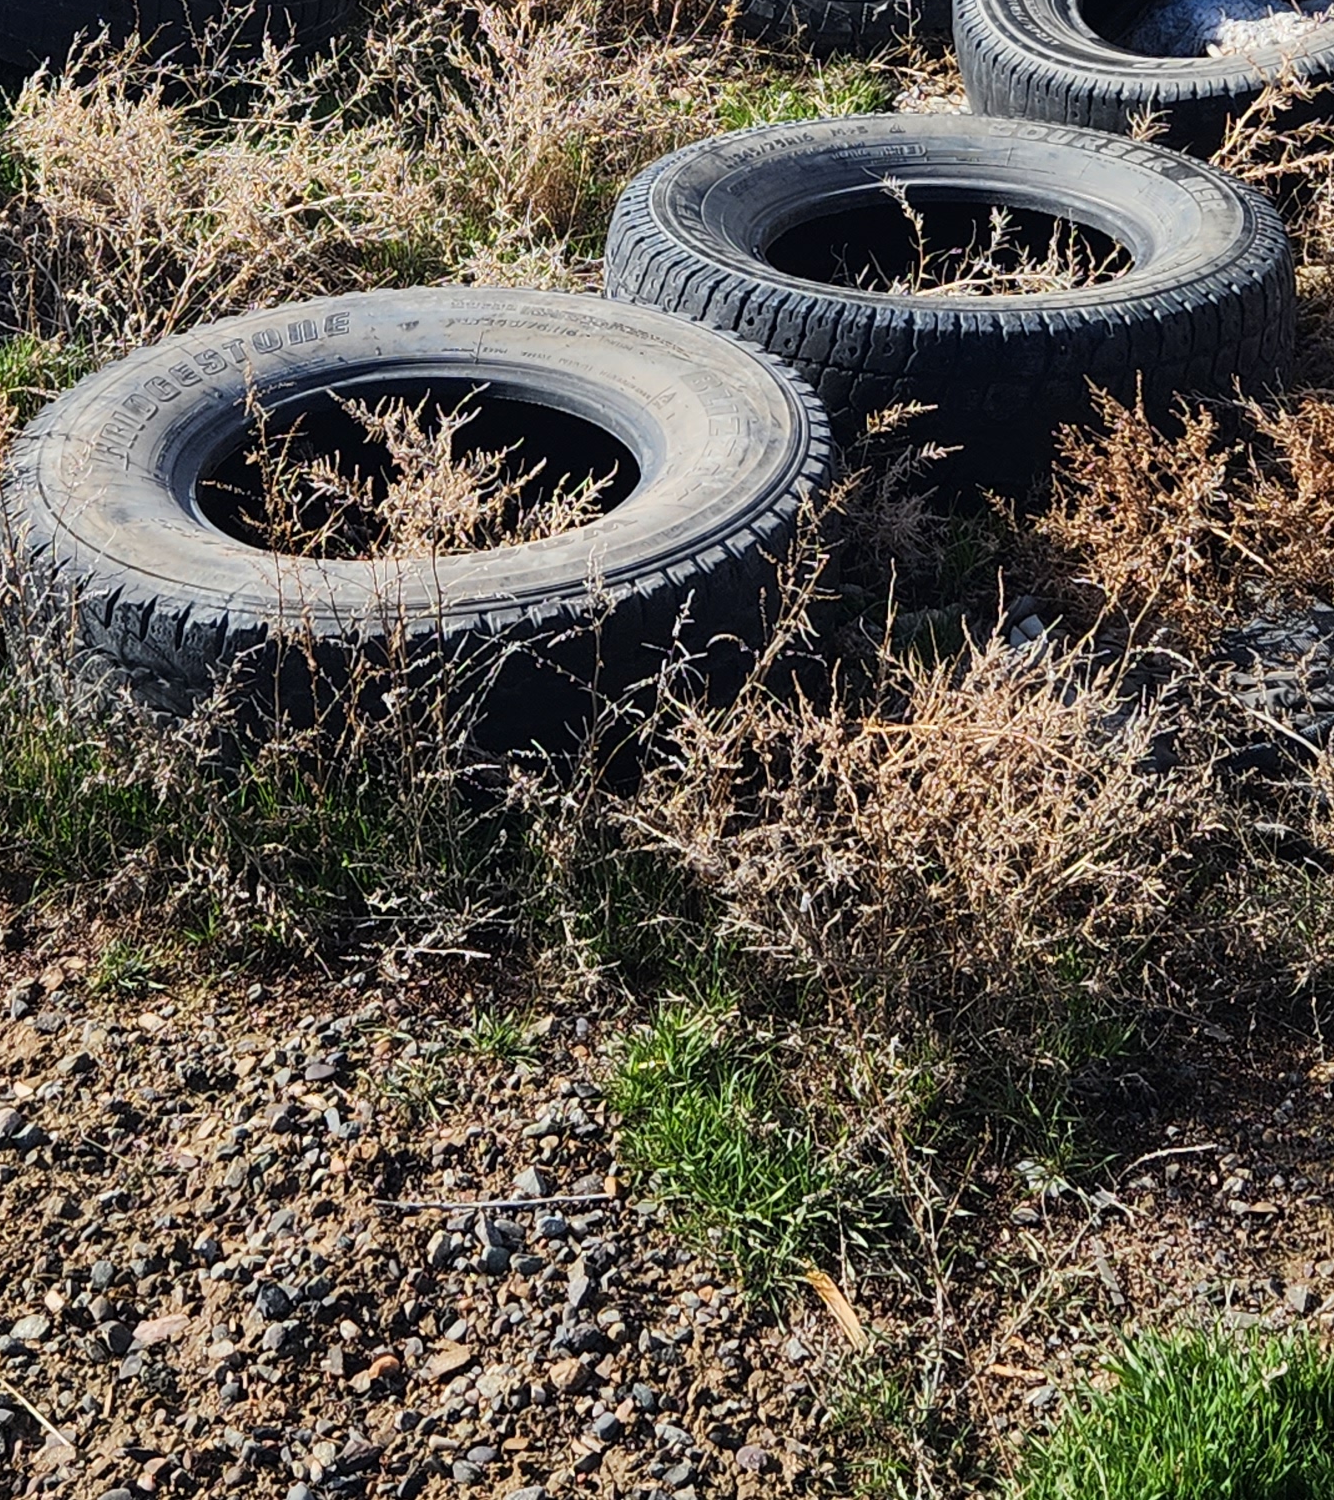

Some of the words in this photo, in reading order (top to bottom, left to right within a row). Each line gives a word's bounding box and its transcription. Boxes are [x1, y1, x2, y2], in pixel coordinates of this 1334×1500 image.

[987, 121, 1177, 173] COURSER
[1178, 175, 1228, 213] MSR
[89, 311, 351, 470] BRIDGESTONE
